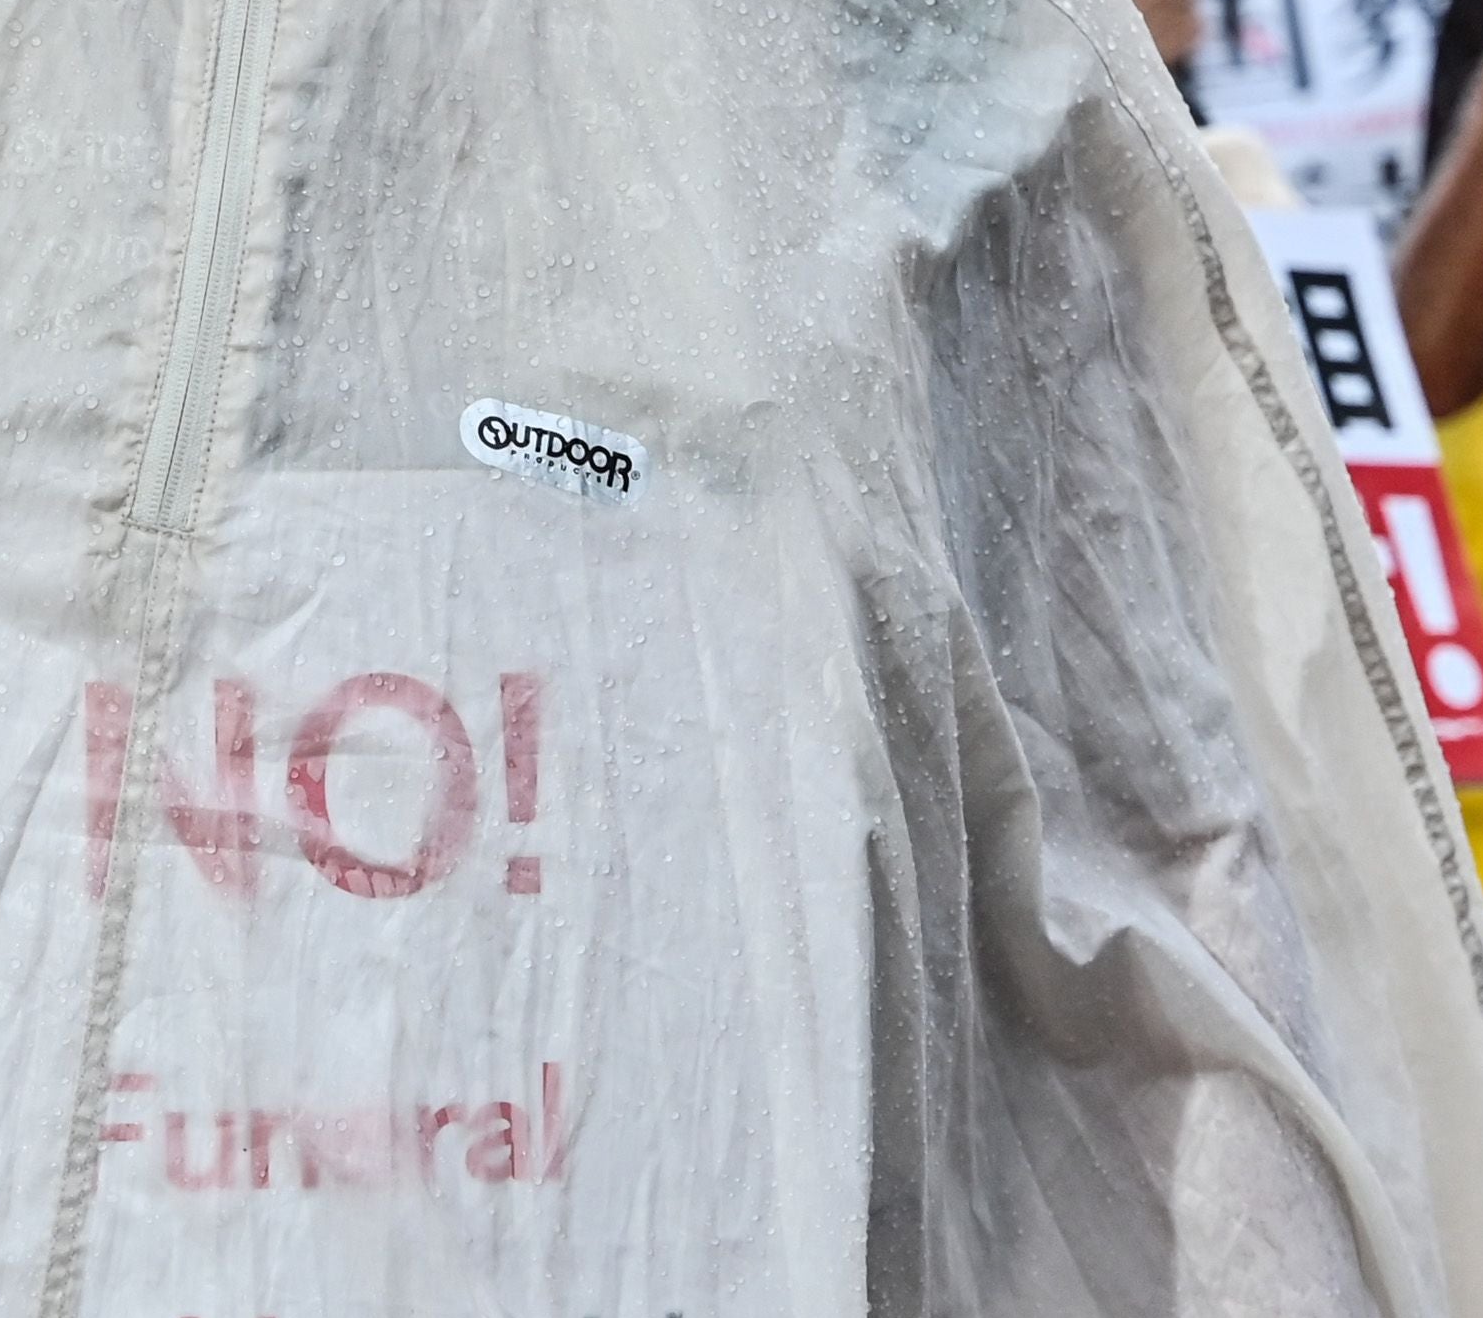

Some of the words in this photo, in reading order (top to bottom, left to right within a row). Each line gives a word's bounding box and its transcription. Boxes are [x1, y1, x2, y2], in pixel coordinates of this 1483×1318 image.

[478, 416, 633, 492] OUTDOOR
[510, 449, 603, 484] PRODUCTS
[85, 672, 541, 899] NO!
